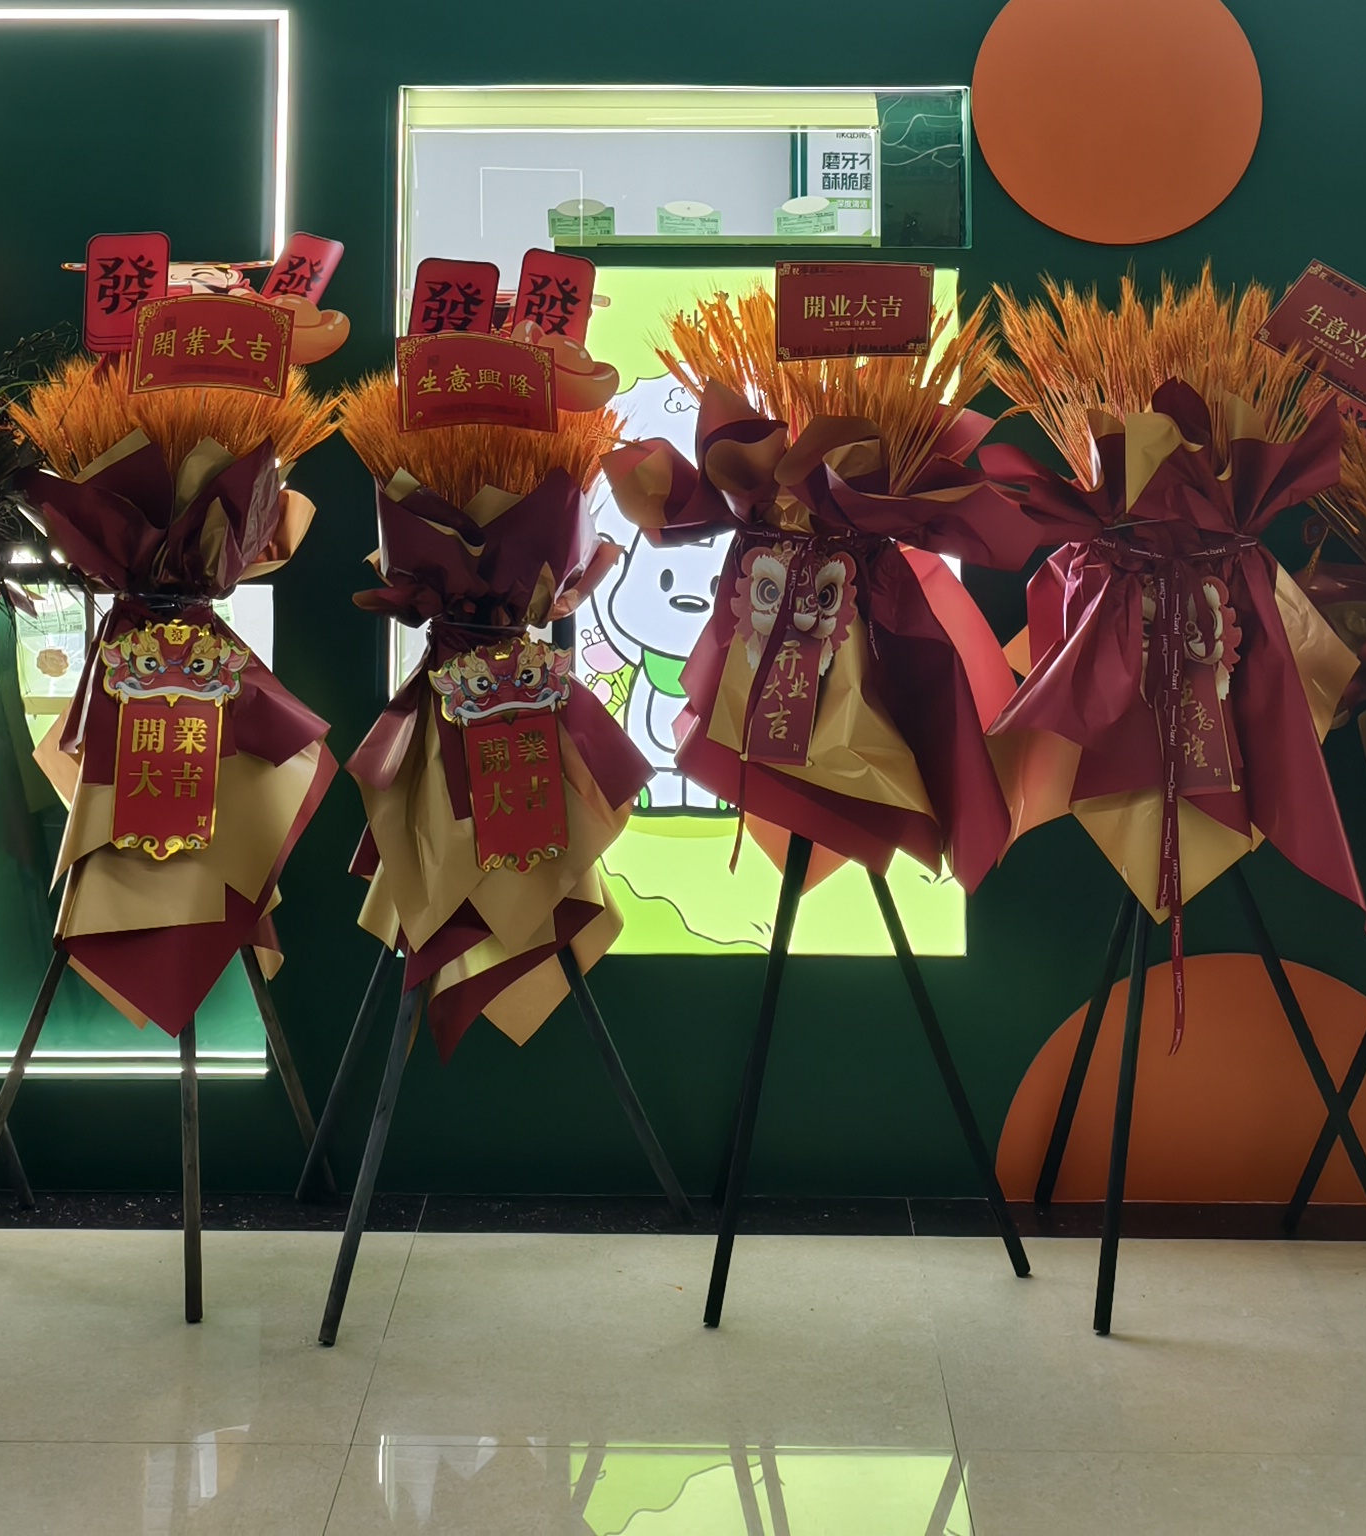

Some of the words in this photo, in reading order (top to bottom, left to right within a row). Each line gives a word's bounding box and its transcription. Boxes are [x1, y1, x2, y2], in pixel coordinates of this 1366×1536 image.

[93, 254, 159, 315] 發
[421, 280, 485, 333] 發
[524, 273, 582, 338] 發
[803, 294, 903, 320] 開业大吉
[151, 326, 272, 362] 開業大吉
[416, 364, 537, 399] 生意興隆
